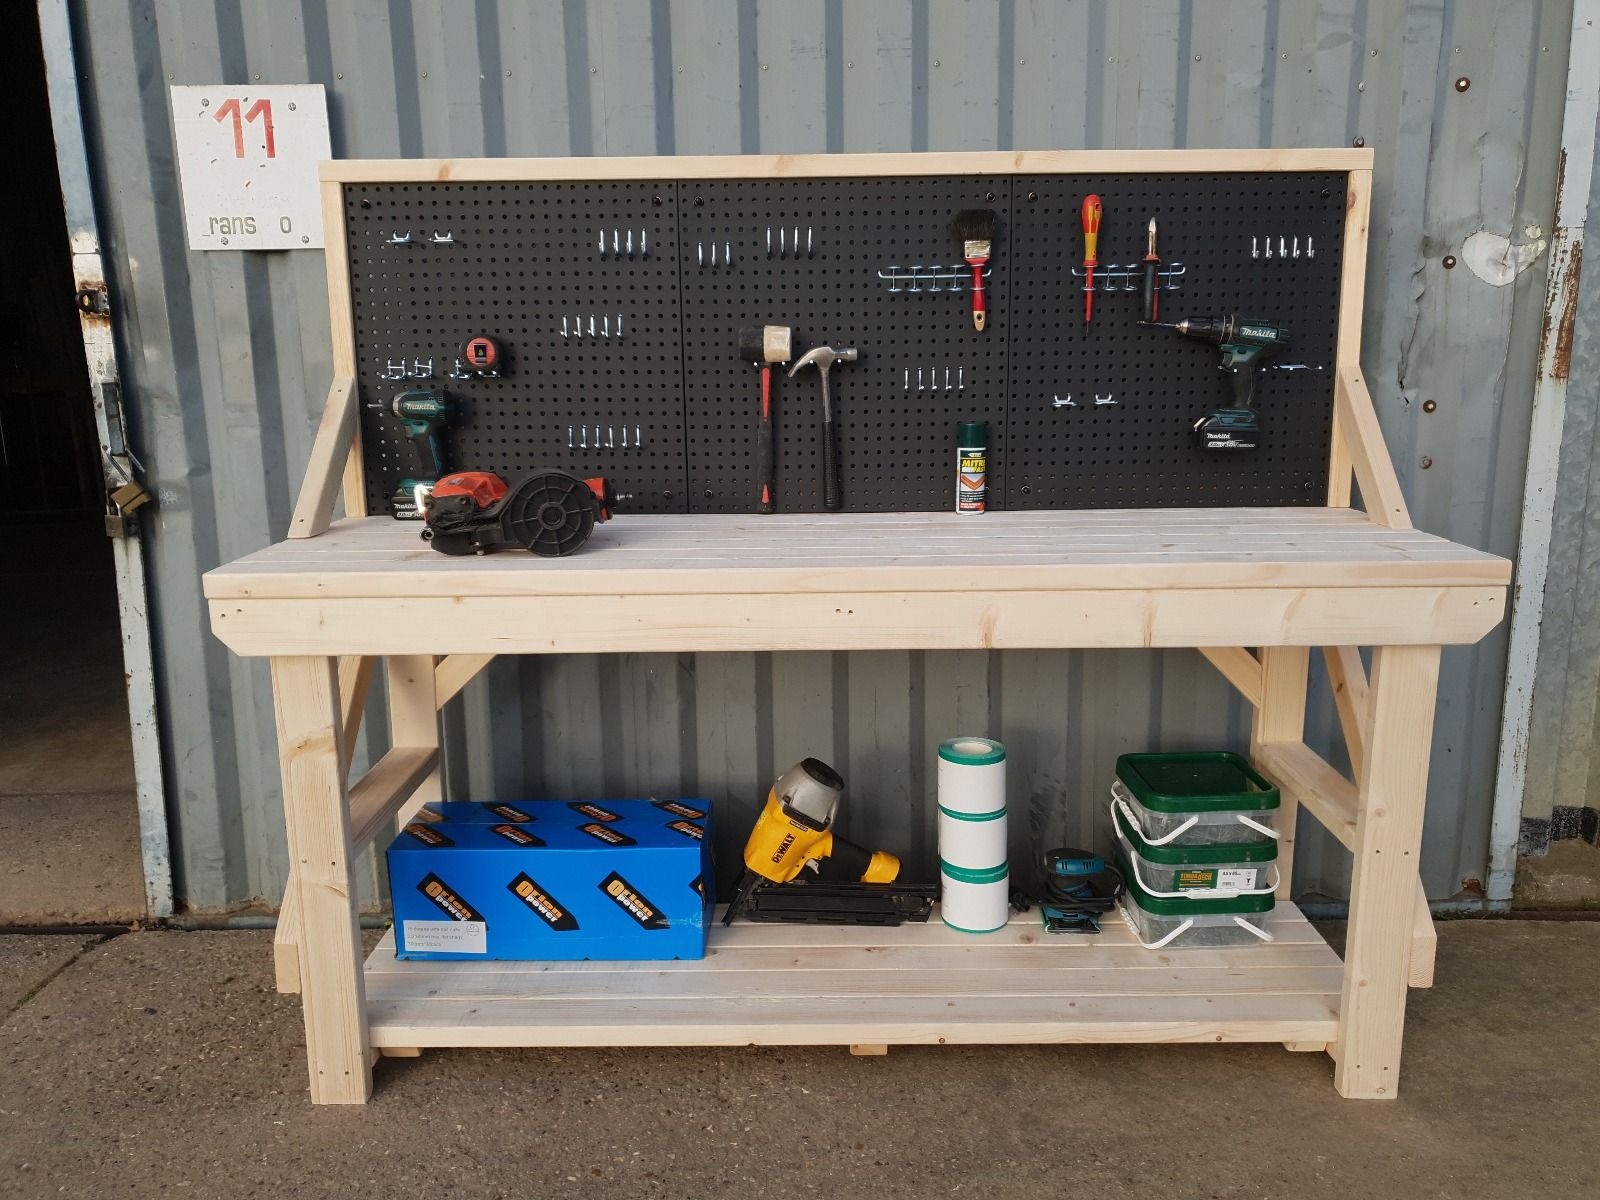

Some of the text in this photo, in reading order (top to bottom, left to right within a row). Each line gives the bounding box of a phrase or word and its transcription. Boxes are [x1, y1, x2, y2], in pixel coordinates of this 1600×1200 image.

[213, 98, 276, 158] 11
[1241, 327, 1277, 339] Makita
[406, 402, 436, 411] Makita
[425, 881, 472, 919] Orion
[516, 880, 563, 919] Orion
[525, 894, 559, 922] power
[607, 879, 654, 918] Orion
[616, 893, 649, 921] power
